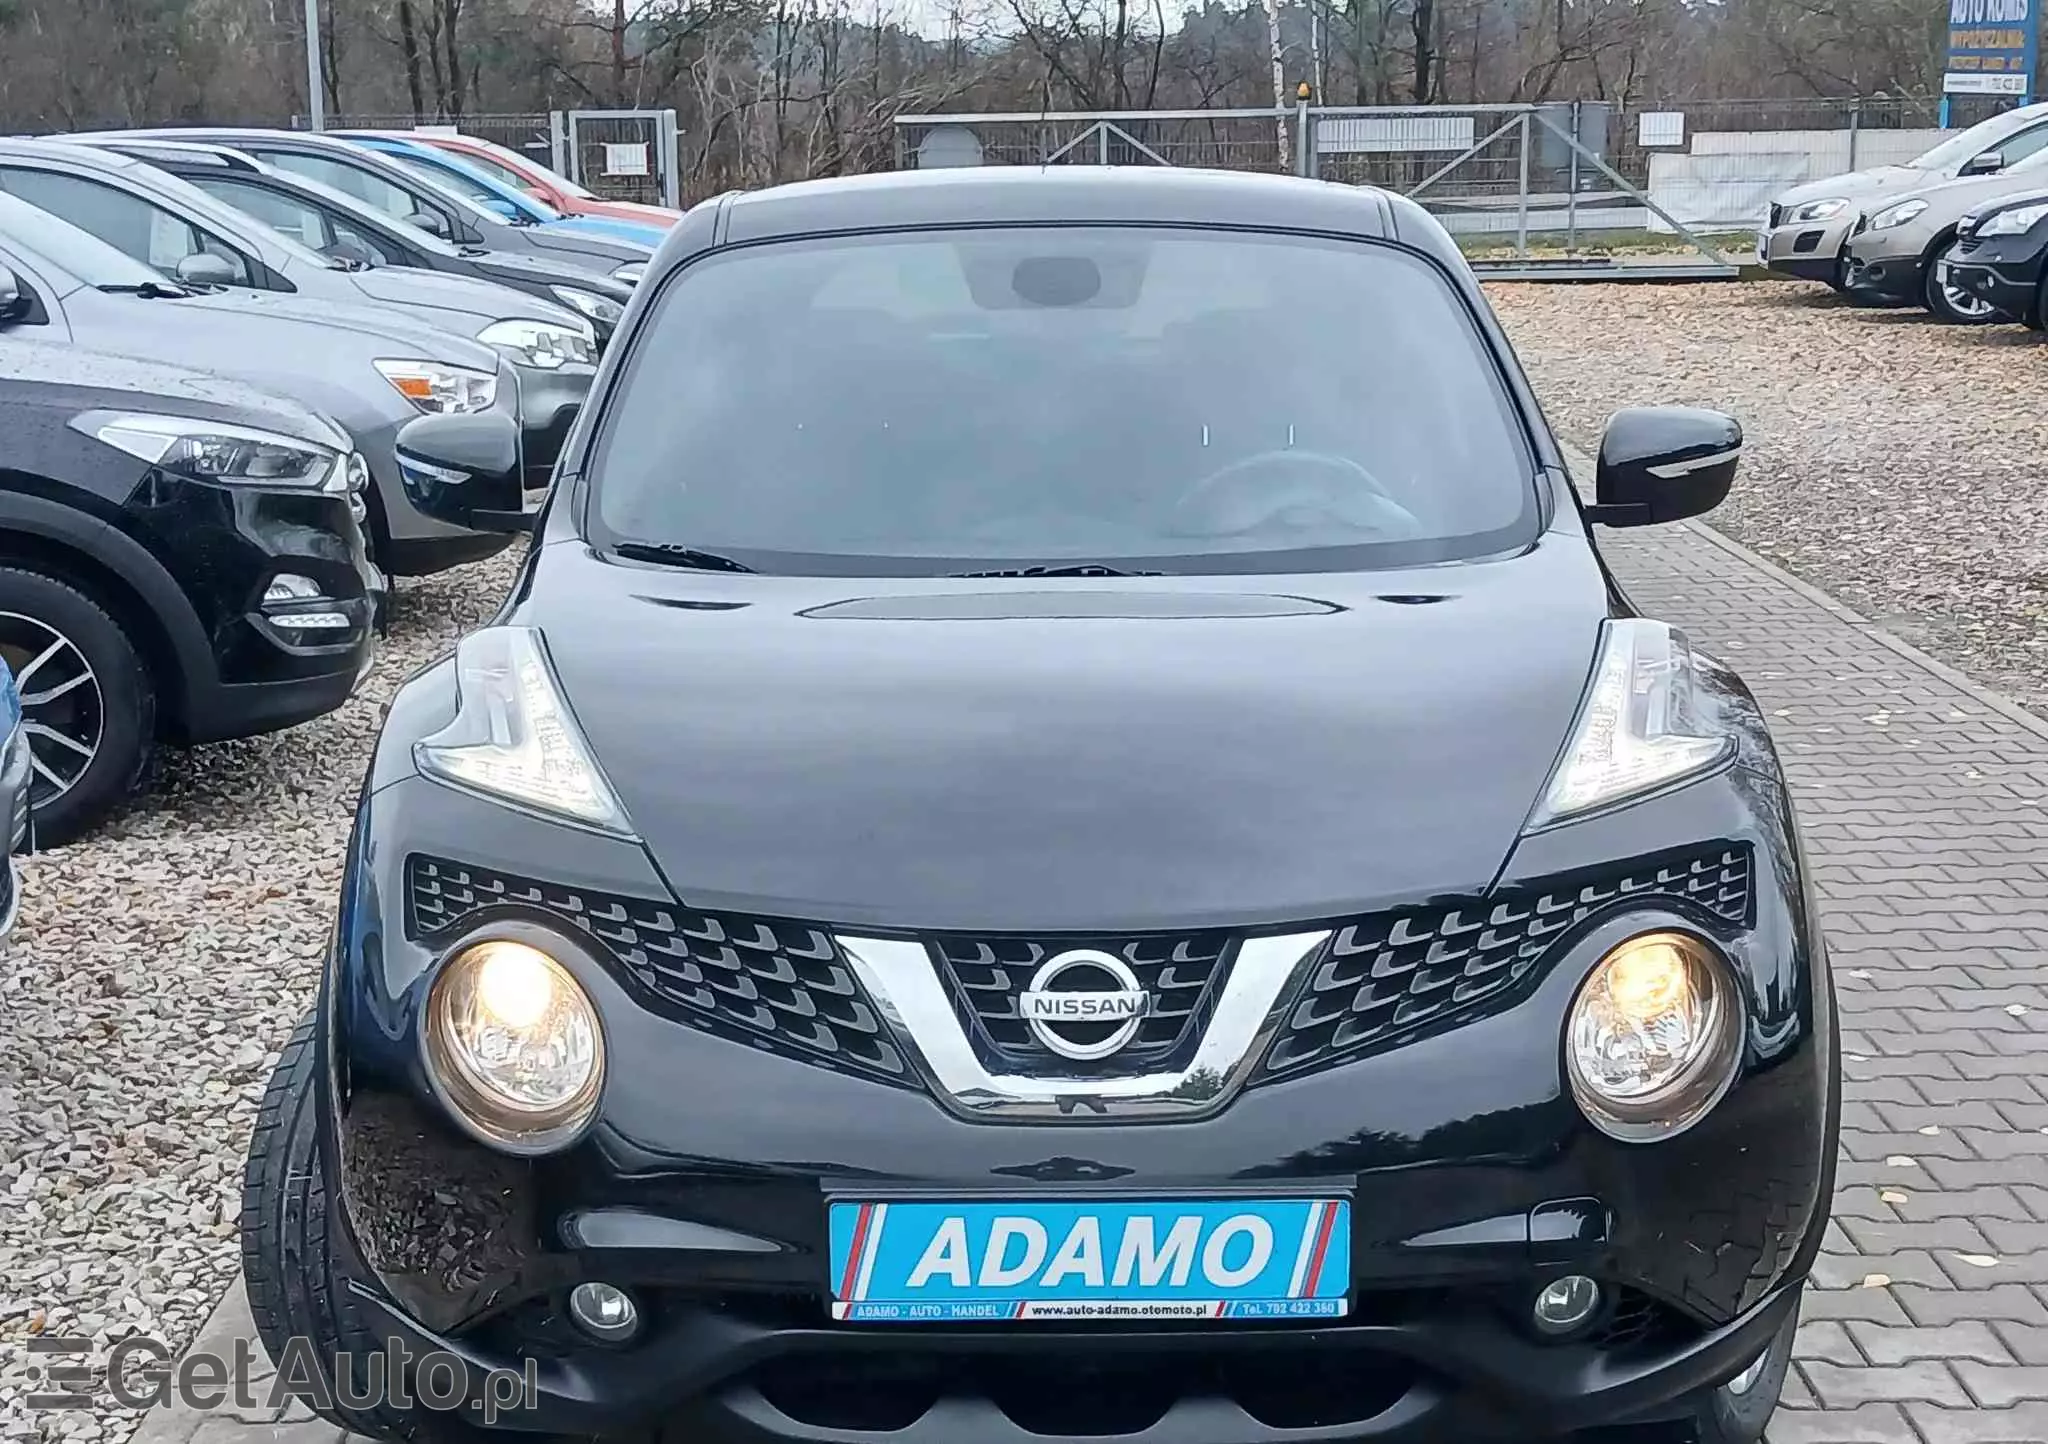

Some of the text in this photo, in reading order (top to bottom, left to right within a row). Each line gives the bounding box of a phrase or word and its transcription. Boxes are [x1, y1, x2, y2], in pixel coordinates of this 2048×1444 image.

[1034, 998, 1136, 1014] NISSAN
[904, 1213, 1275, 1288] ADAMO
[857, 1304, 899, 1317] ADAMO
[909, 1304, 942, 1317] AUTO
[951, 1303, 1000, 1317] HANDEL
[1031, 1303, 1208, 1317] www.auto-adamo.otomoto.pl
[1289, 1302, 1312, 1314] 422
